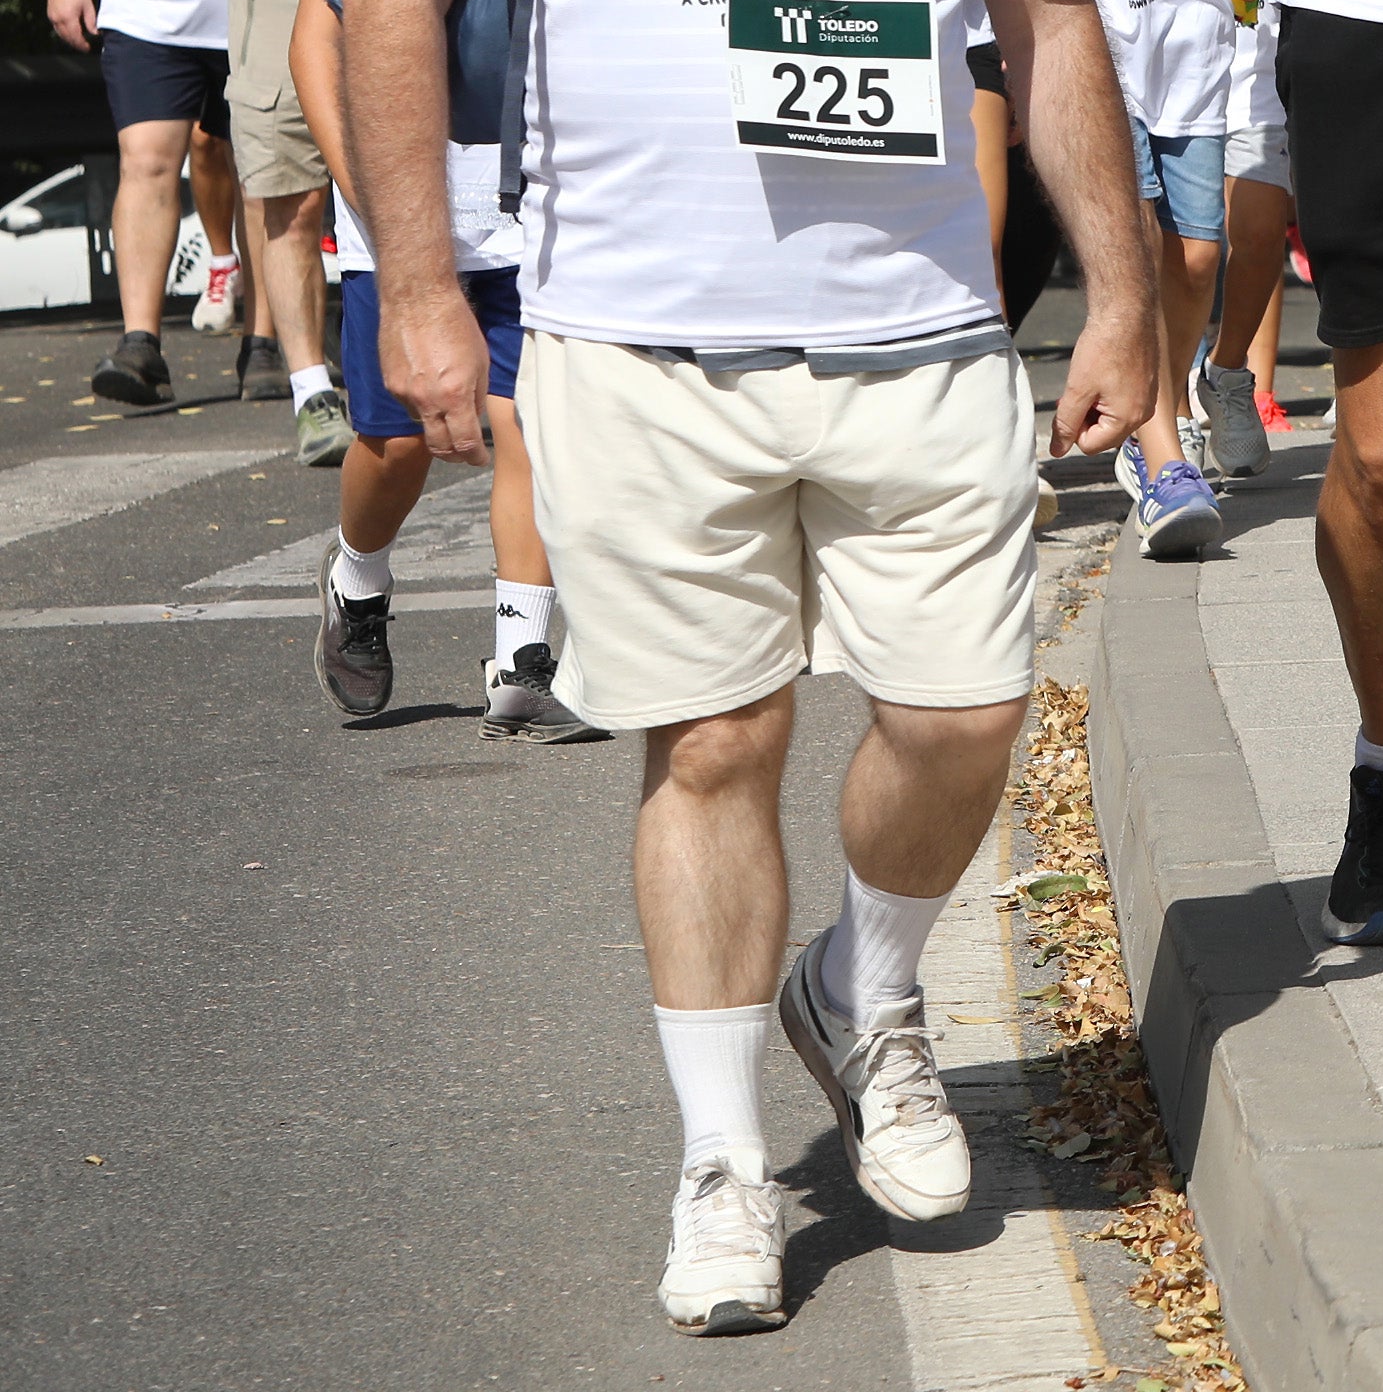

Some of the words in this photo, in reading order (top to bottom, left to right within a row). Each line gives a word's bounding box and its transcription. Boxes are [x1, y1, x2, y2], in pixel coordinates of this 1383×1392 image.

[819, 19, 879, 33] TOLEDO
[819, 32, 879, 44] Diputación
[772, 62, 895, 127] 225
[787, 132, 885, 148] www.diputoledo.es
